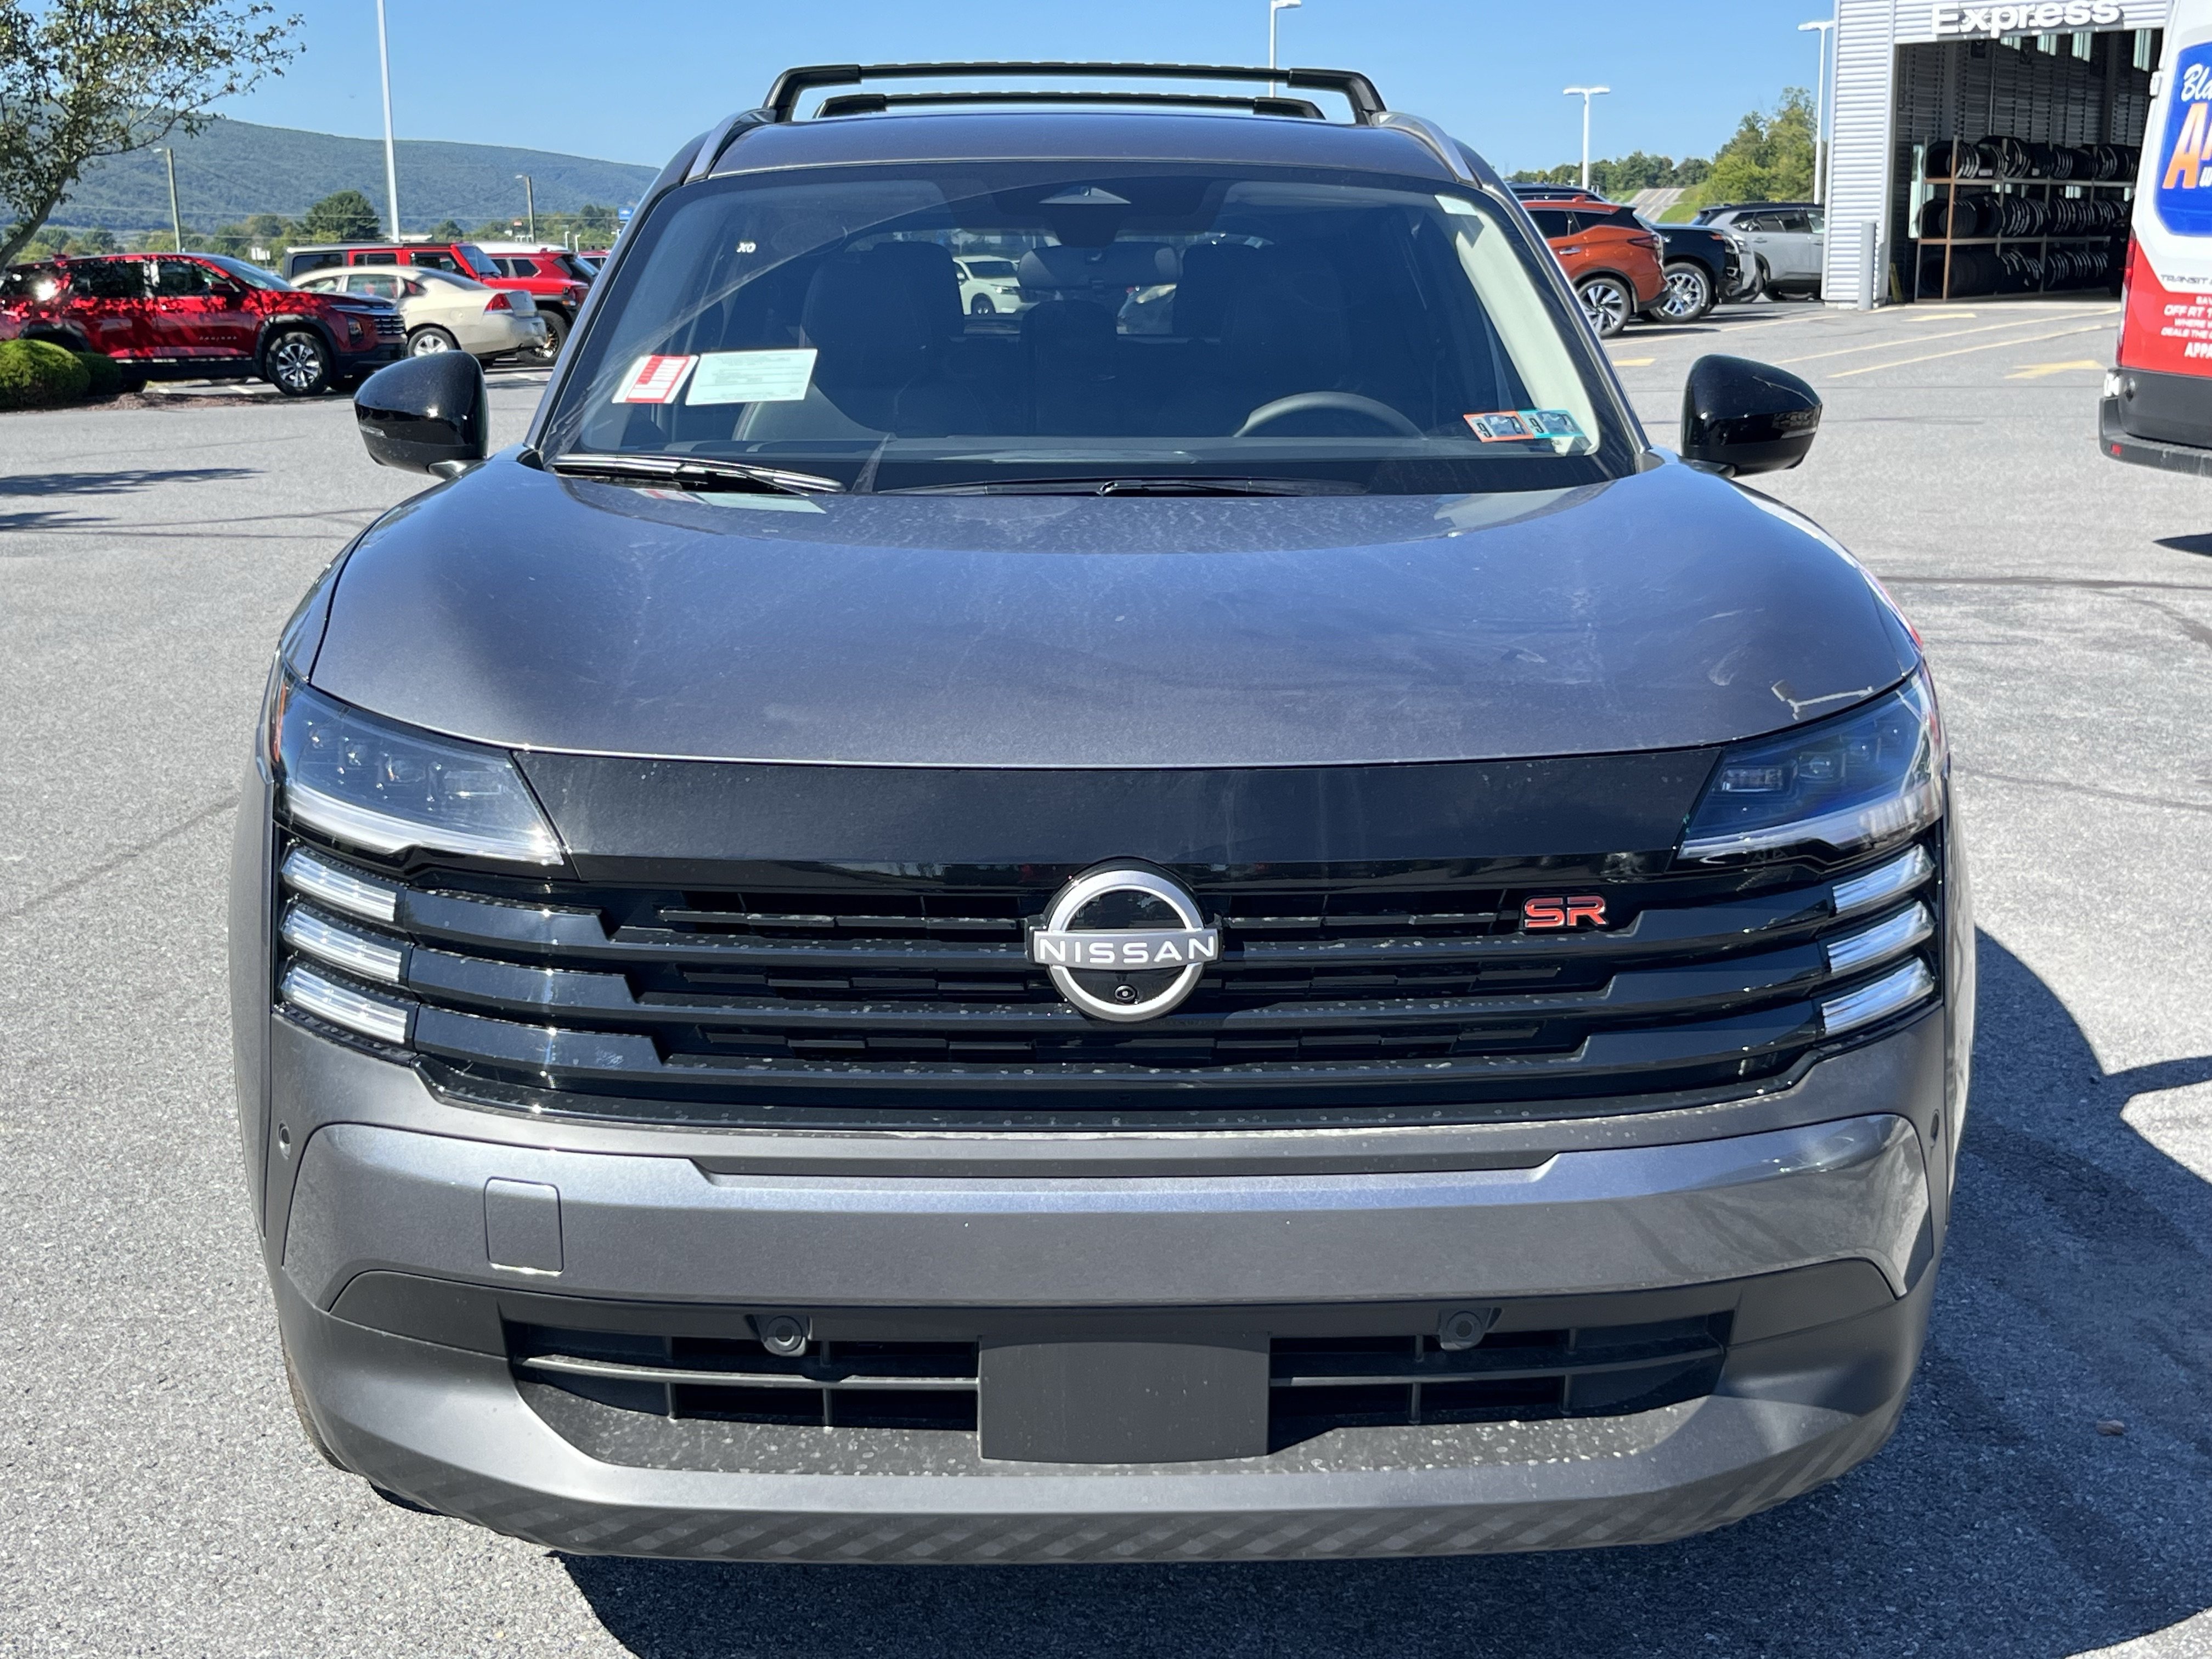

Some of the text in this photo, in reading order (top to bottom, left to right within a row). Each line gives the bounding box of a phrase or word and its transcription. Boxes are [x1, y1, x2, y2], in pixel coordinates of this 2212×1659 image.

[1931, 1, 2122, 38] Express
[1525, 895, 1606, 928] SR
[1040, 936, 1214, 963] NISSAN
